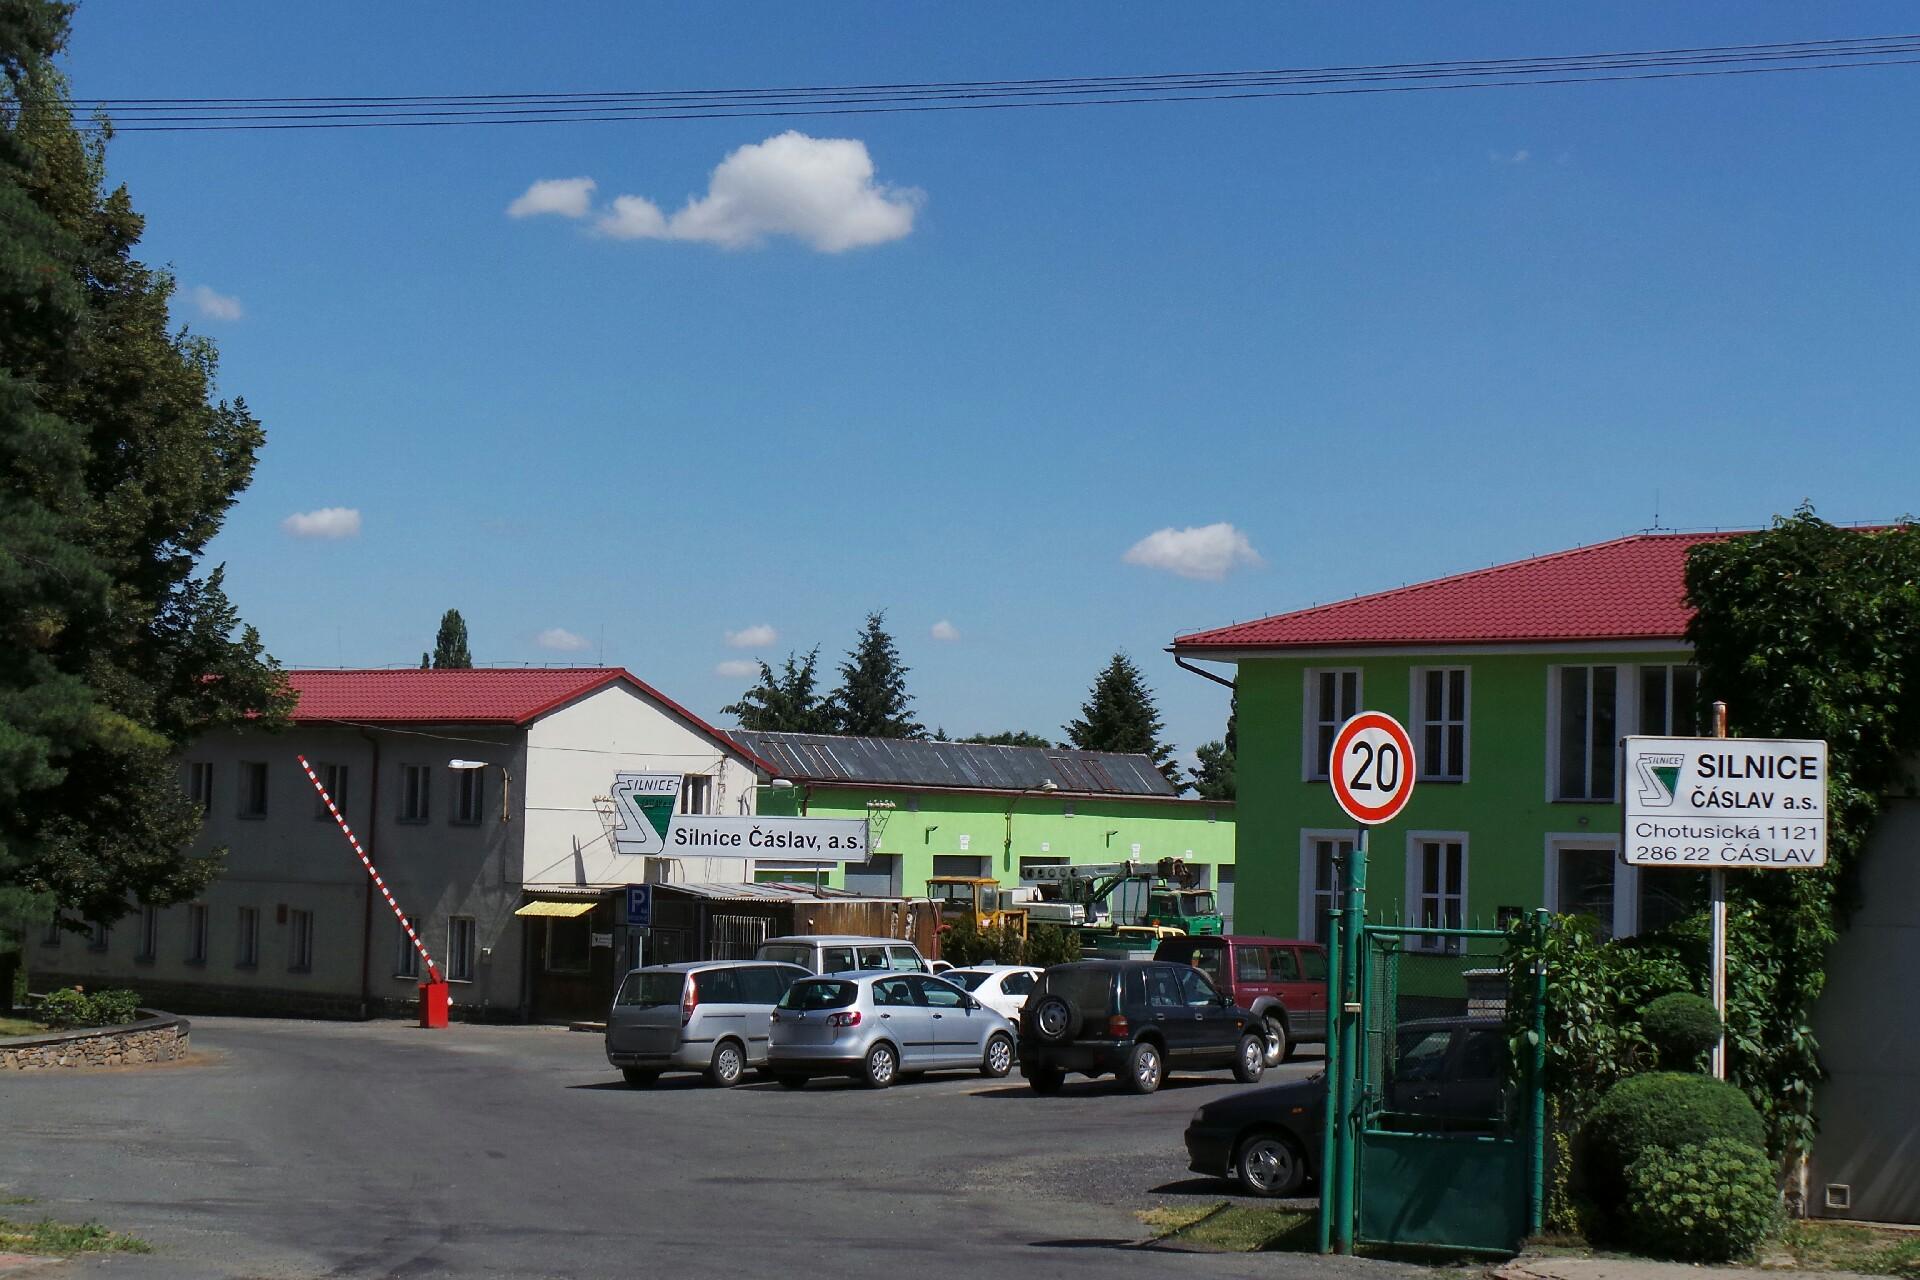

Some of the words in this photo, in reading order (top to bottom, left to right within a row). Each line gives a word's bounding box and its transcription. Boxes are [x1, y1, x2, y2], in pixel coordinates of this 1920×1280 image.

[1350, 741, 1399, 792] 20
[1697, 753, 1817, 779] SILNICE
[627, 779, 674, 790] SILNICE
[1691, 785, 1774, 808] ČÁSLAV
[1783, 796, 1818, 810] a.s.
[674, 828, 741, 847] Silnice
[749, 825, 822, 852] Čáslav,
[828, 834, 864, 850] a.s.
[1636, 822, 1760, 840] Chotusická
[1767, 826, 1817, 840] 1121
[1636, 846, 1677, 861] 286
[1683, 846, 1710, 861] 22
[1721, 843, 1815, 862] ČÁSLAV
